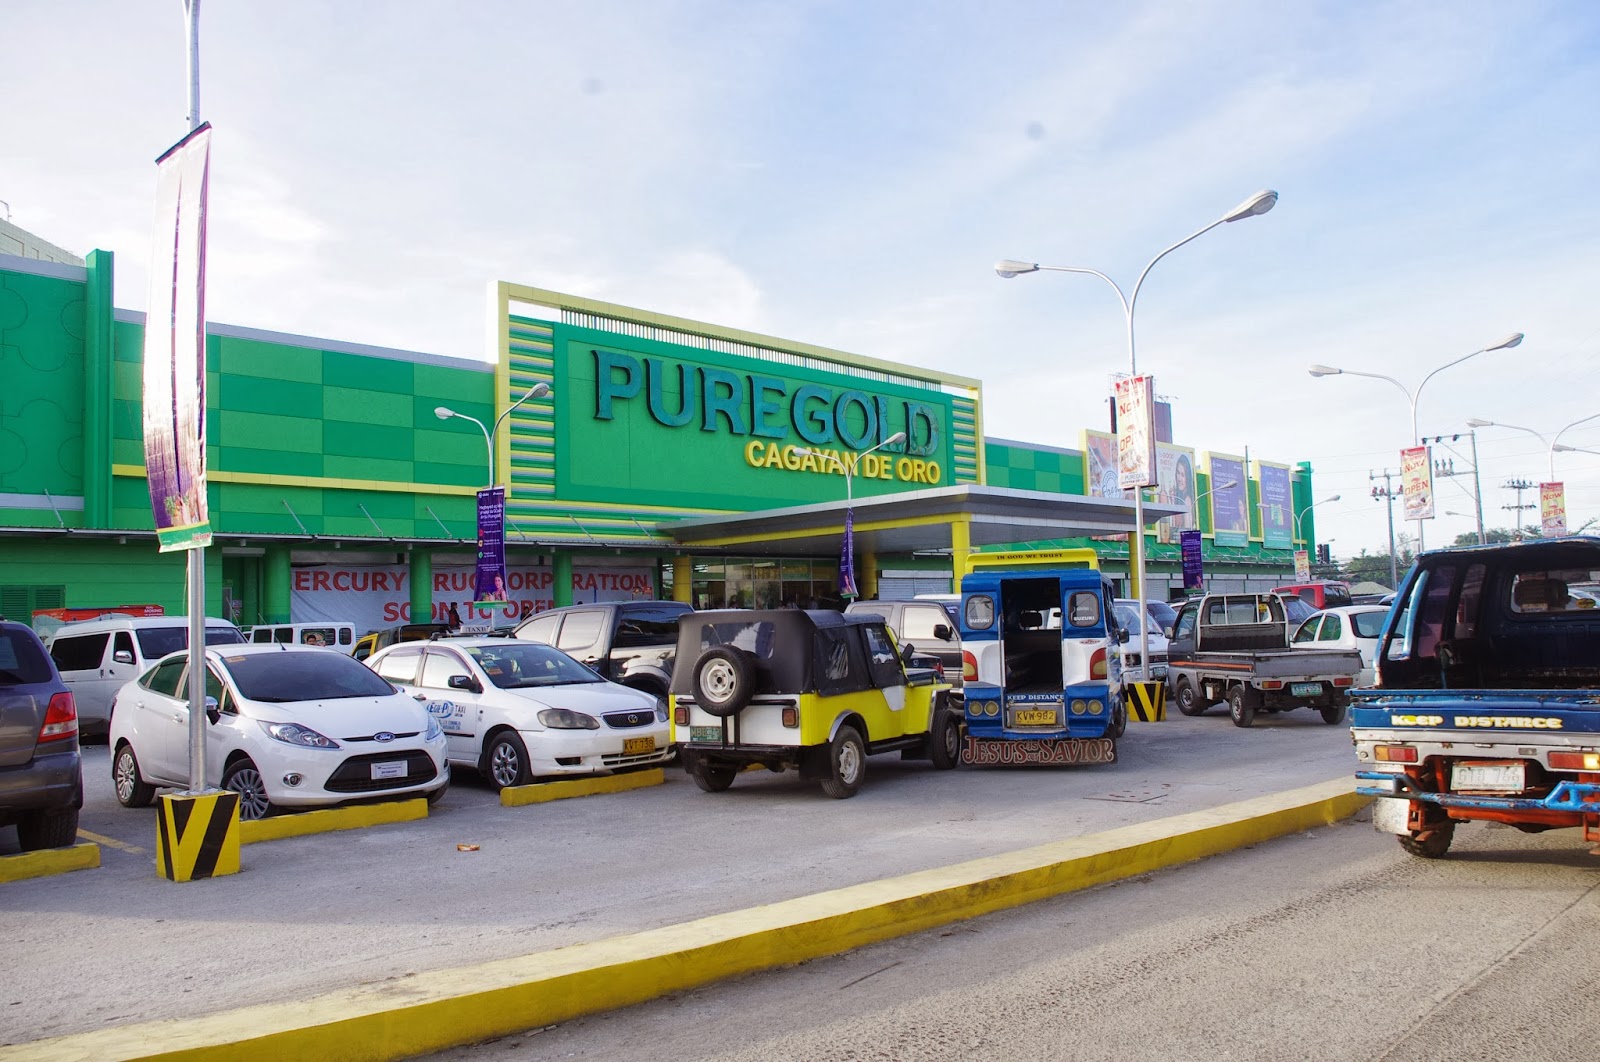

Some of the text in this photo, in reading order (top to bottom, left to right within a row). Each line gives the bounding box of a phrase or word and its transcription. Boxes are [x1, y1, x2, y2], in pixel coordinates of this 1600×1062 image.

[591, 349, 940, 457] PUREGOLD
[745, 440, 941, 485] CAGAYAN DE ORO
[1404, 479, 1429, 496] OPEN
[1543, 492, 1562, 501] NOW
[1542, 508, 1565, 518] OPEN
[294, 570, 407, 592] ERCURY
[1454, 716, 1563, 728] DISTANCE
[961, 735, 1027, 764] JESUS
[1038, 738, 1115, 763] SAVIOR
